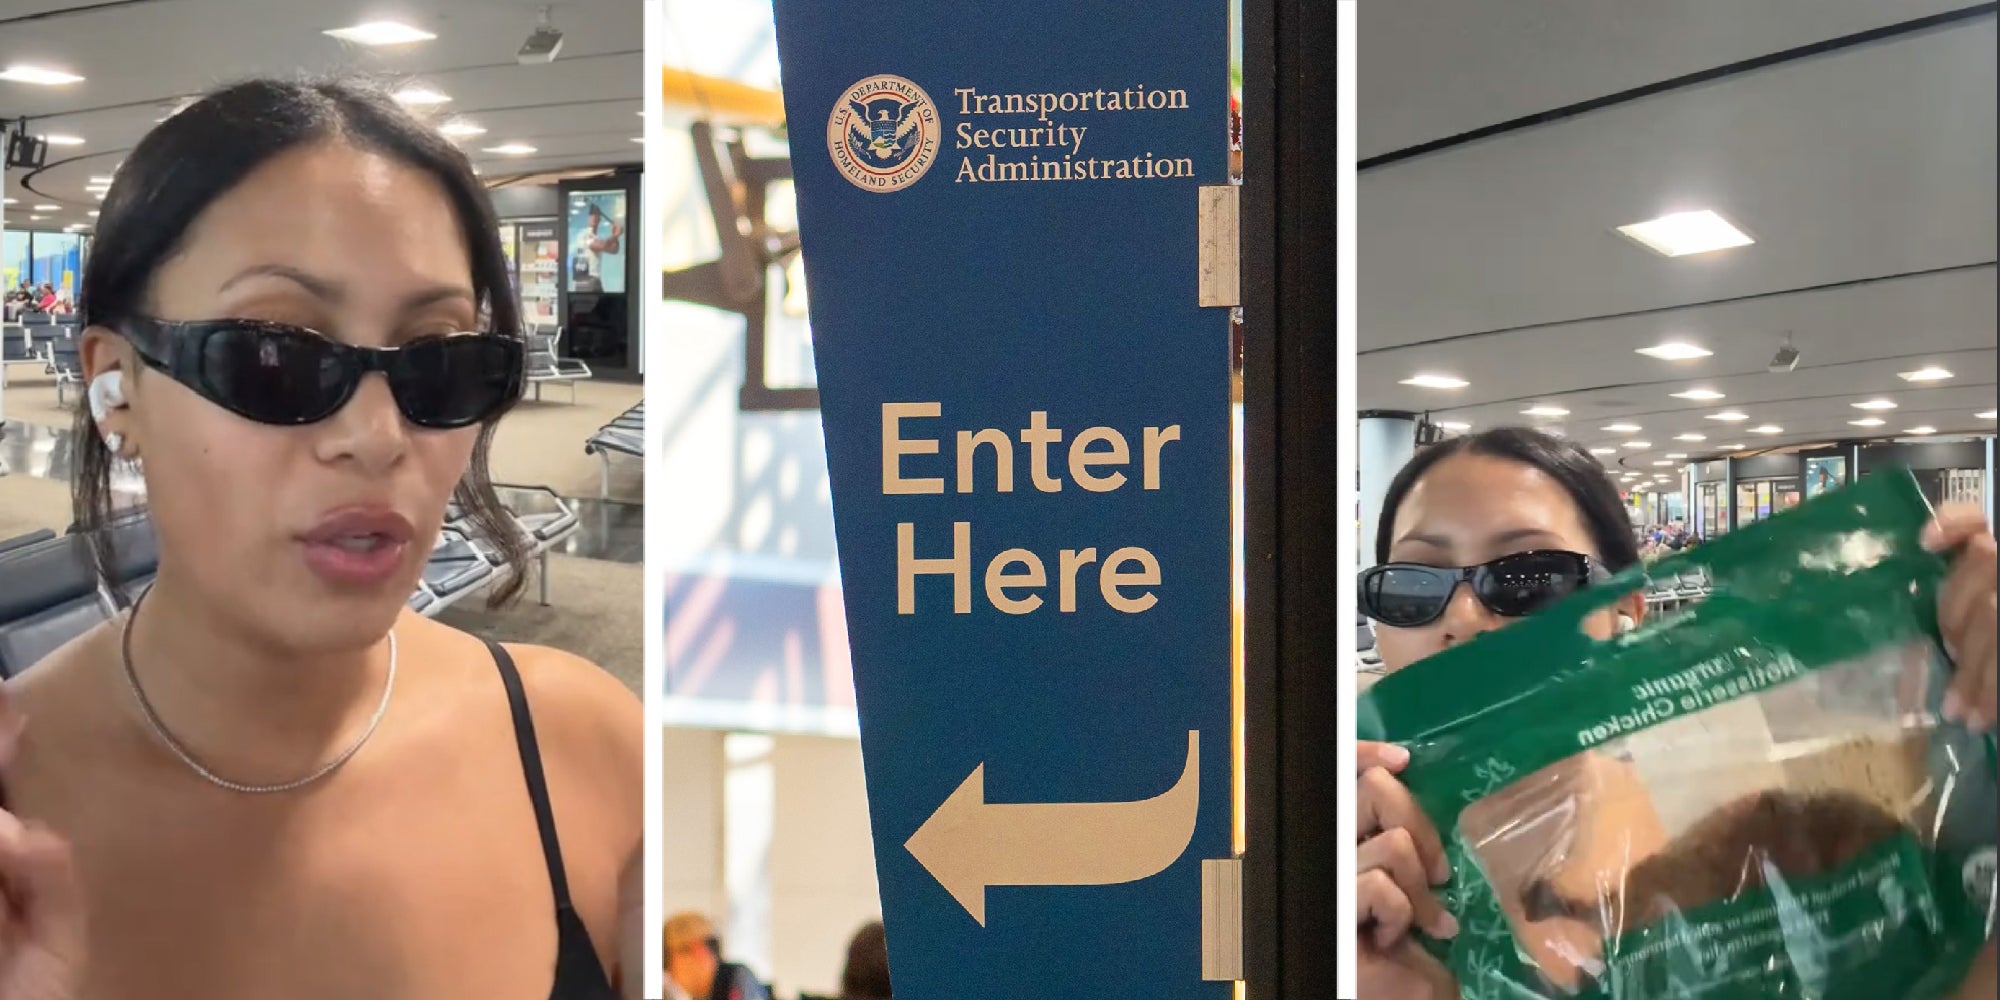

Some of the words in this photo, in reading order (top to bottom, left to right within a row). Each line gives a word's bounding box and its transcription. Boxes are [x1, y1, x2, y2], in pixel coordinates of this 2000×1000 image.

[851, 80, 927, 108] DEPARTMENT
[922, 109, 934, 124] OF
[954, 83, 1190, 122] Transportation
[956, 120, 1087, 155] Security
[834, 141, 886, 187] HOMELAND
[891, 137, 934, 186] SECURITY
[954, 152, 1196, 183] Administration
[881, 401, 1181, 495] Enter
[897, 521, 1162, 615] Here
